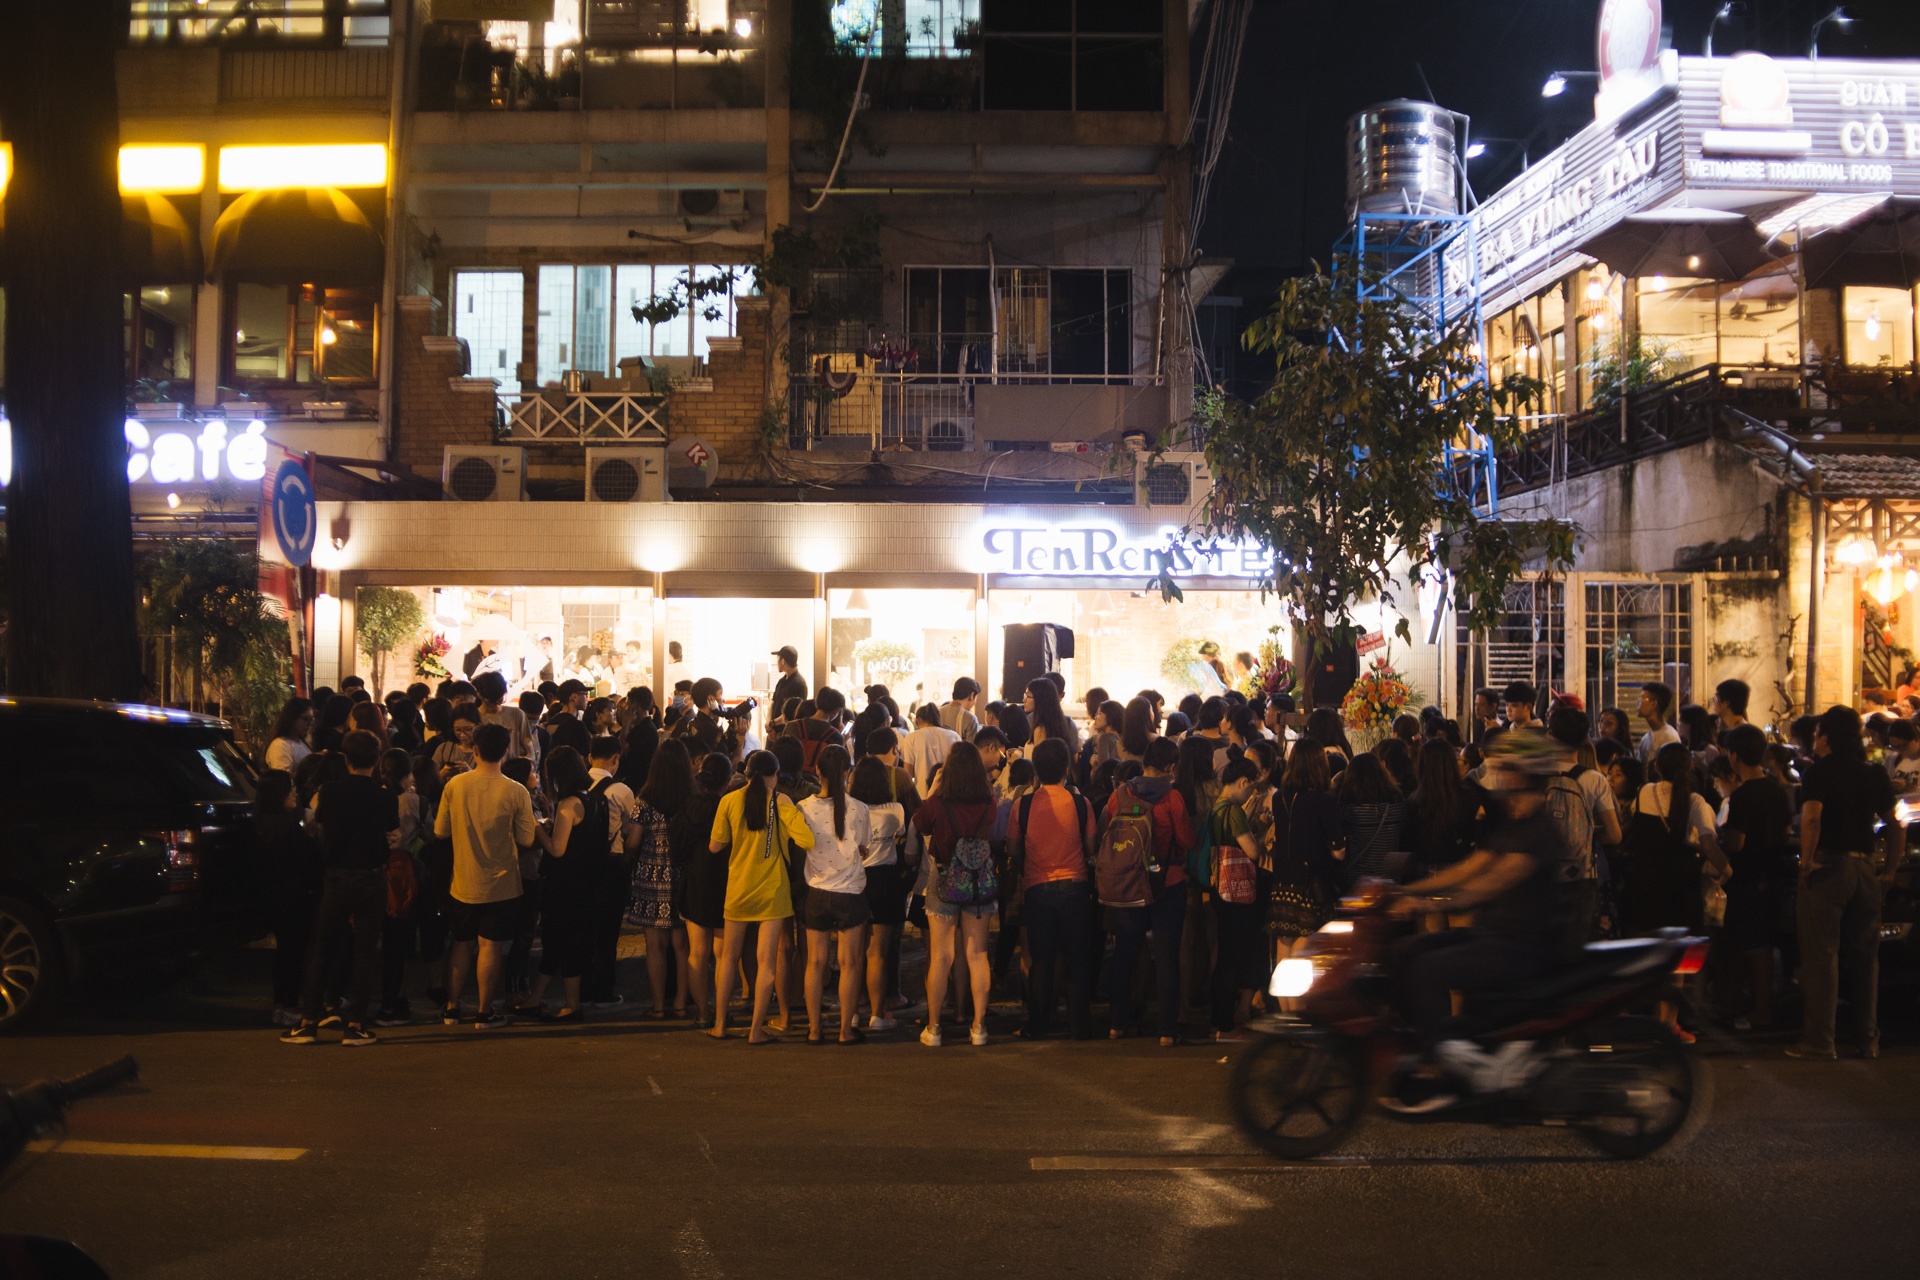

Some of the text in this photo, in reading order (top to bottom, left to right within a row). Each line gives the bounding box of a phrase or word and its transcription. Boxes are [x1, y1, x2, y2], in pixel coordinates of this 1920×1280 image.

[1840, 112, 1889, 157] CÔ
[1601, 131, 1658, 197] TÀU
[1688, 160, 1892, 182] VIETNAMESE TRADITIONAL FOODS
[1203, 548, 1270, 573] TE
